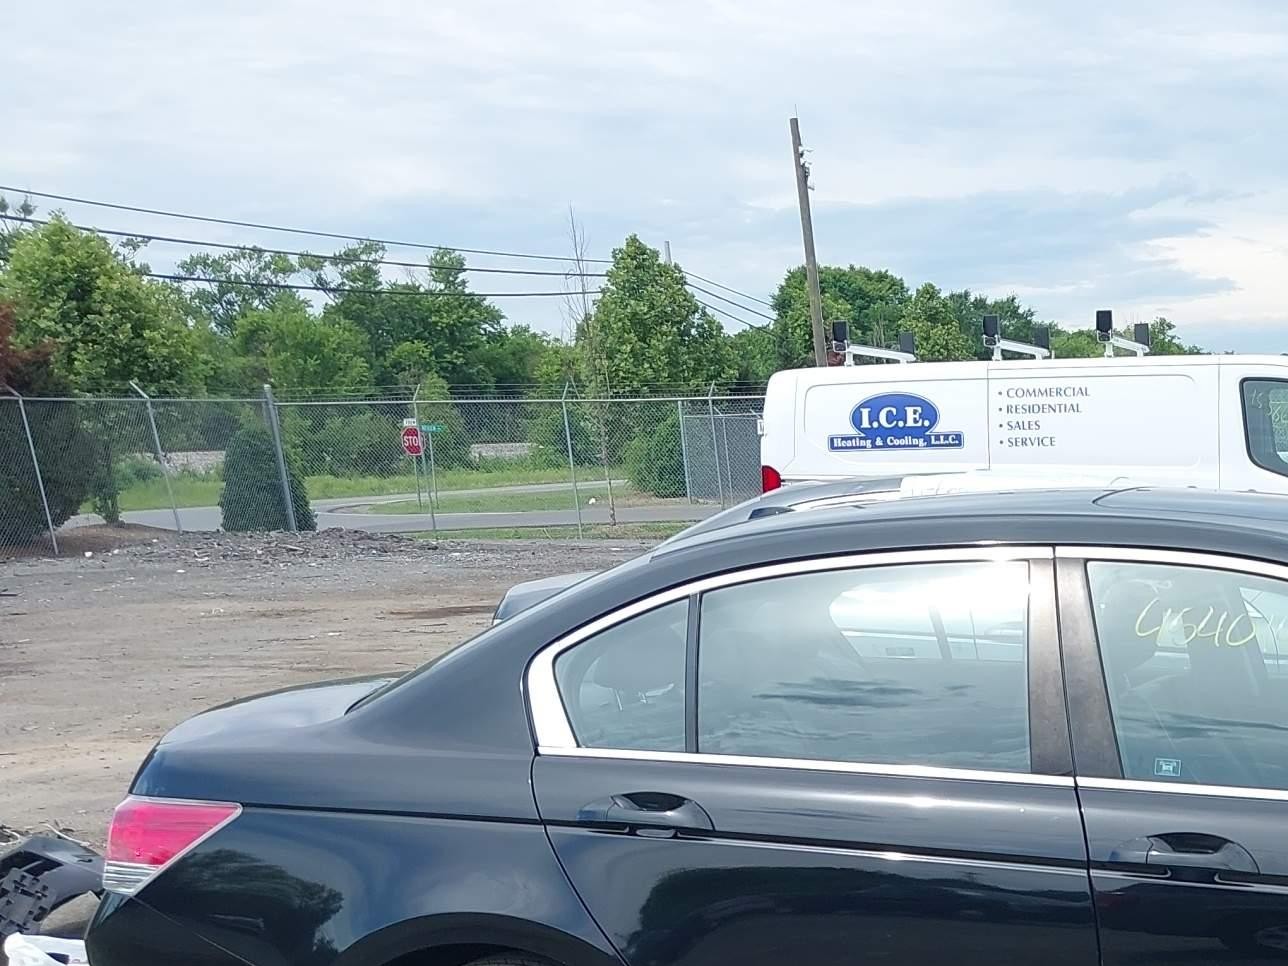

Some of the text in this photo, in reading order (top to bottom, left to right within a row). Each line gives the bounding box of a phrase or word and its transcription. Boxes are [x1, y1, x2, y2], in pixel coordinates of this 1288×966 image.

[1006, 386, 1090, 399] COMMERCIAL
[1006, 402, 1082, 415] RESIDENTIAL
[860, 406, 930, 428] I.C.E.
[1007, 420, 1041, 431] SALES
[403, 435, 420, 447] STO
[833, 437, 872, 448] Heating
[875, 437, 883, 446] &
[931, 434, 959, 445] L.L.C.
[1007, 436, 1056, 447] SERVICE
